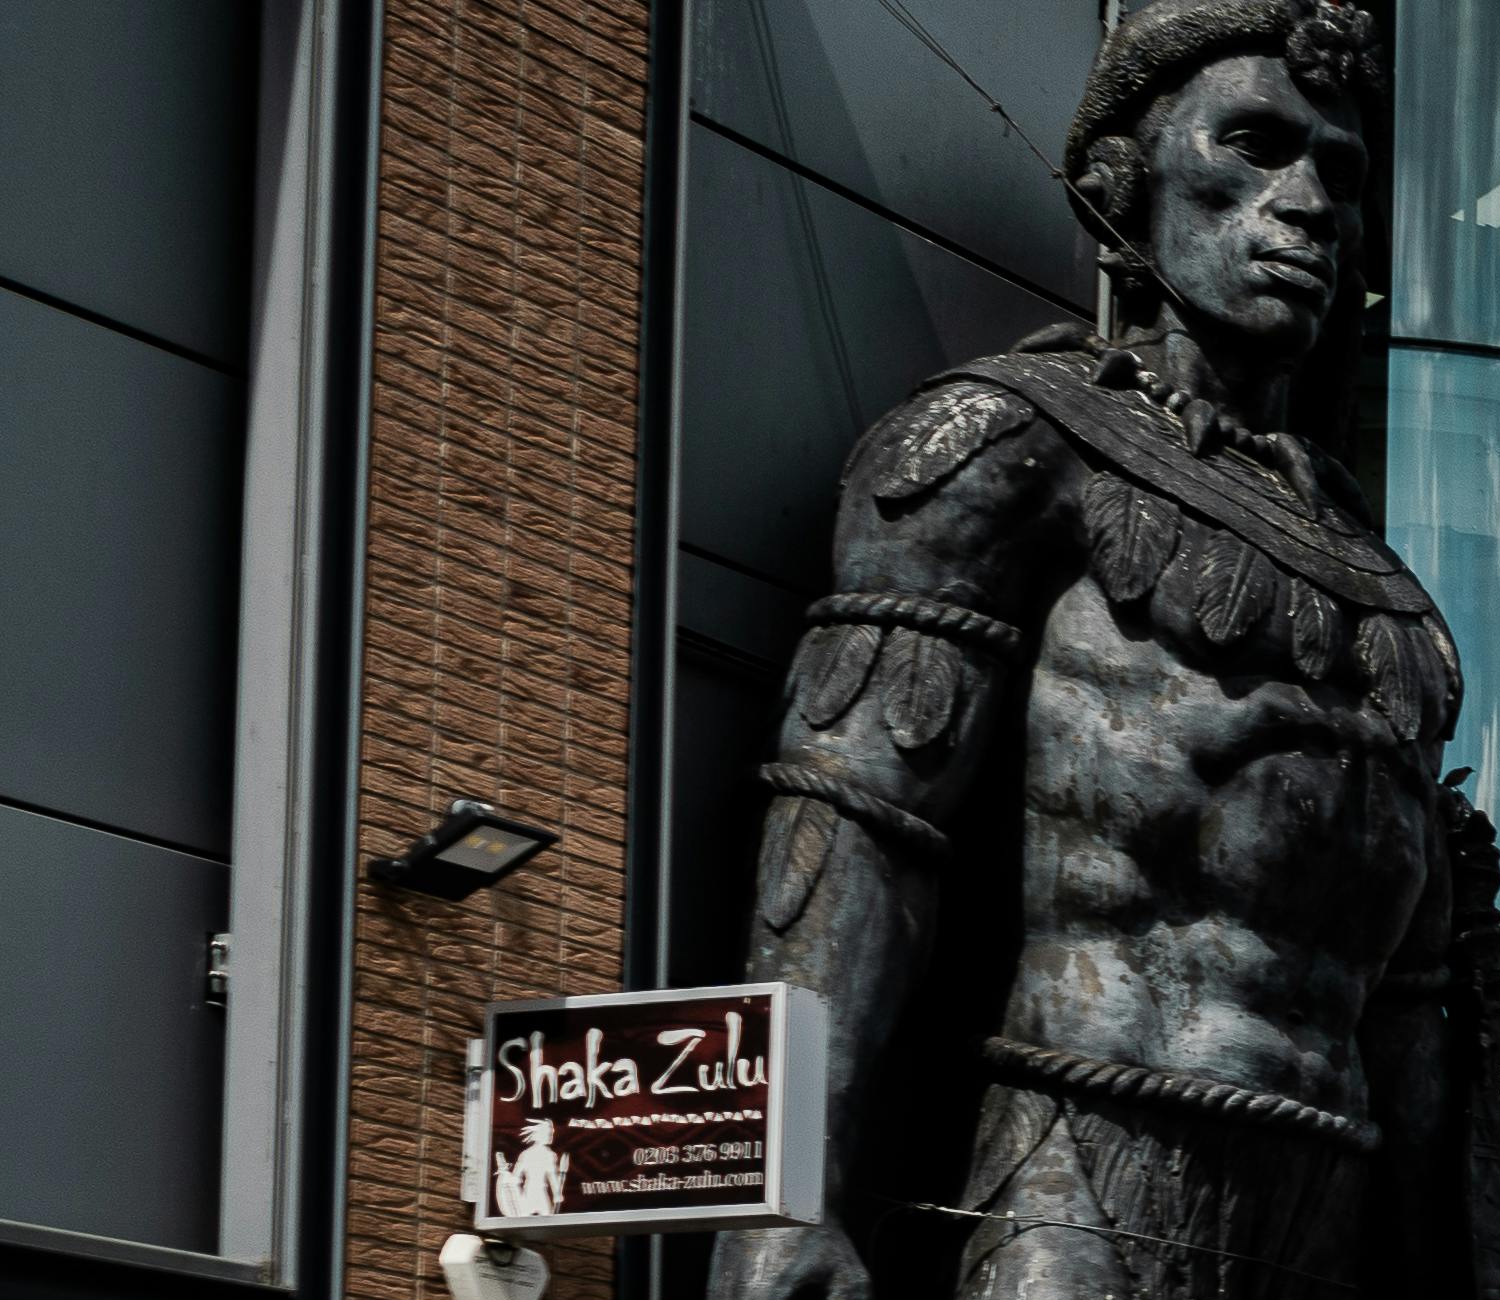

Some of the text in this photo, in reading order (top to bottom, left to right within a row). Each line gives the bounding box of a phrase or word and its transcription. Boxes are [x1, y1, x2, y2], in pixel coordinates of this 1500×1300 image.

[498, 1011, 769, 1108] Shaka Zulu
[719, 1141, 763, 1160] 9911
[580, 1170, 764, 1194] www.shaka-zulu.com
